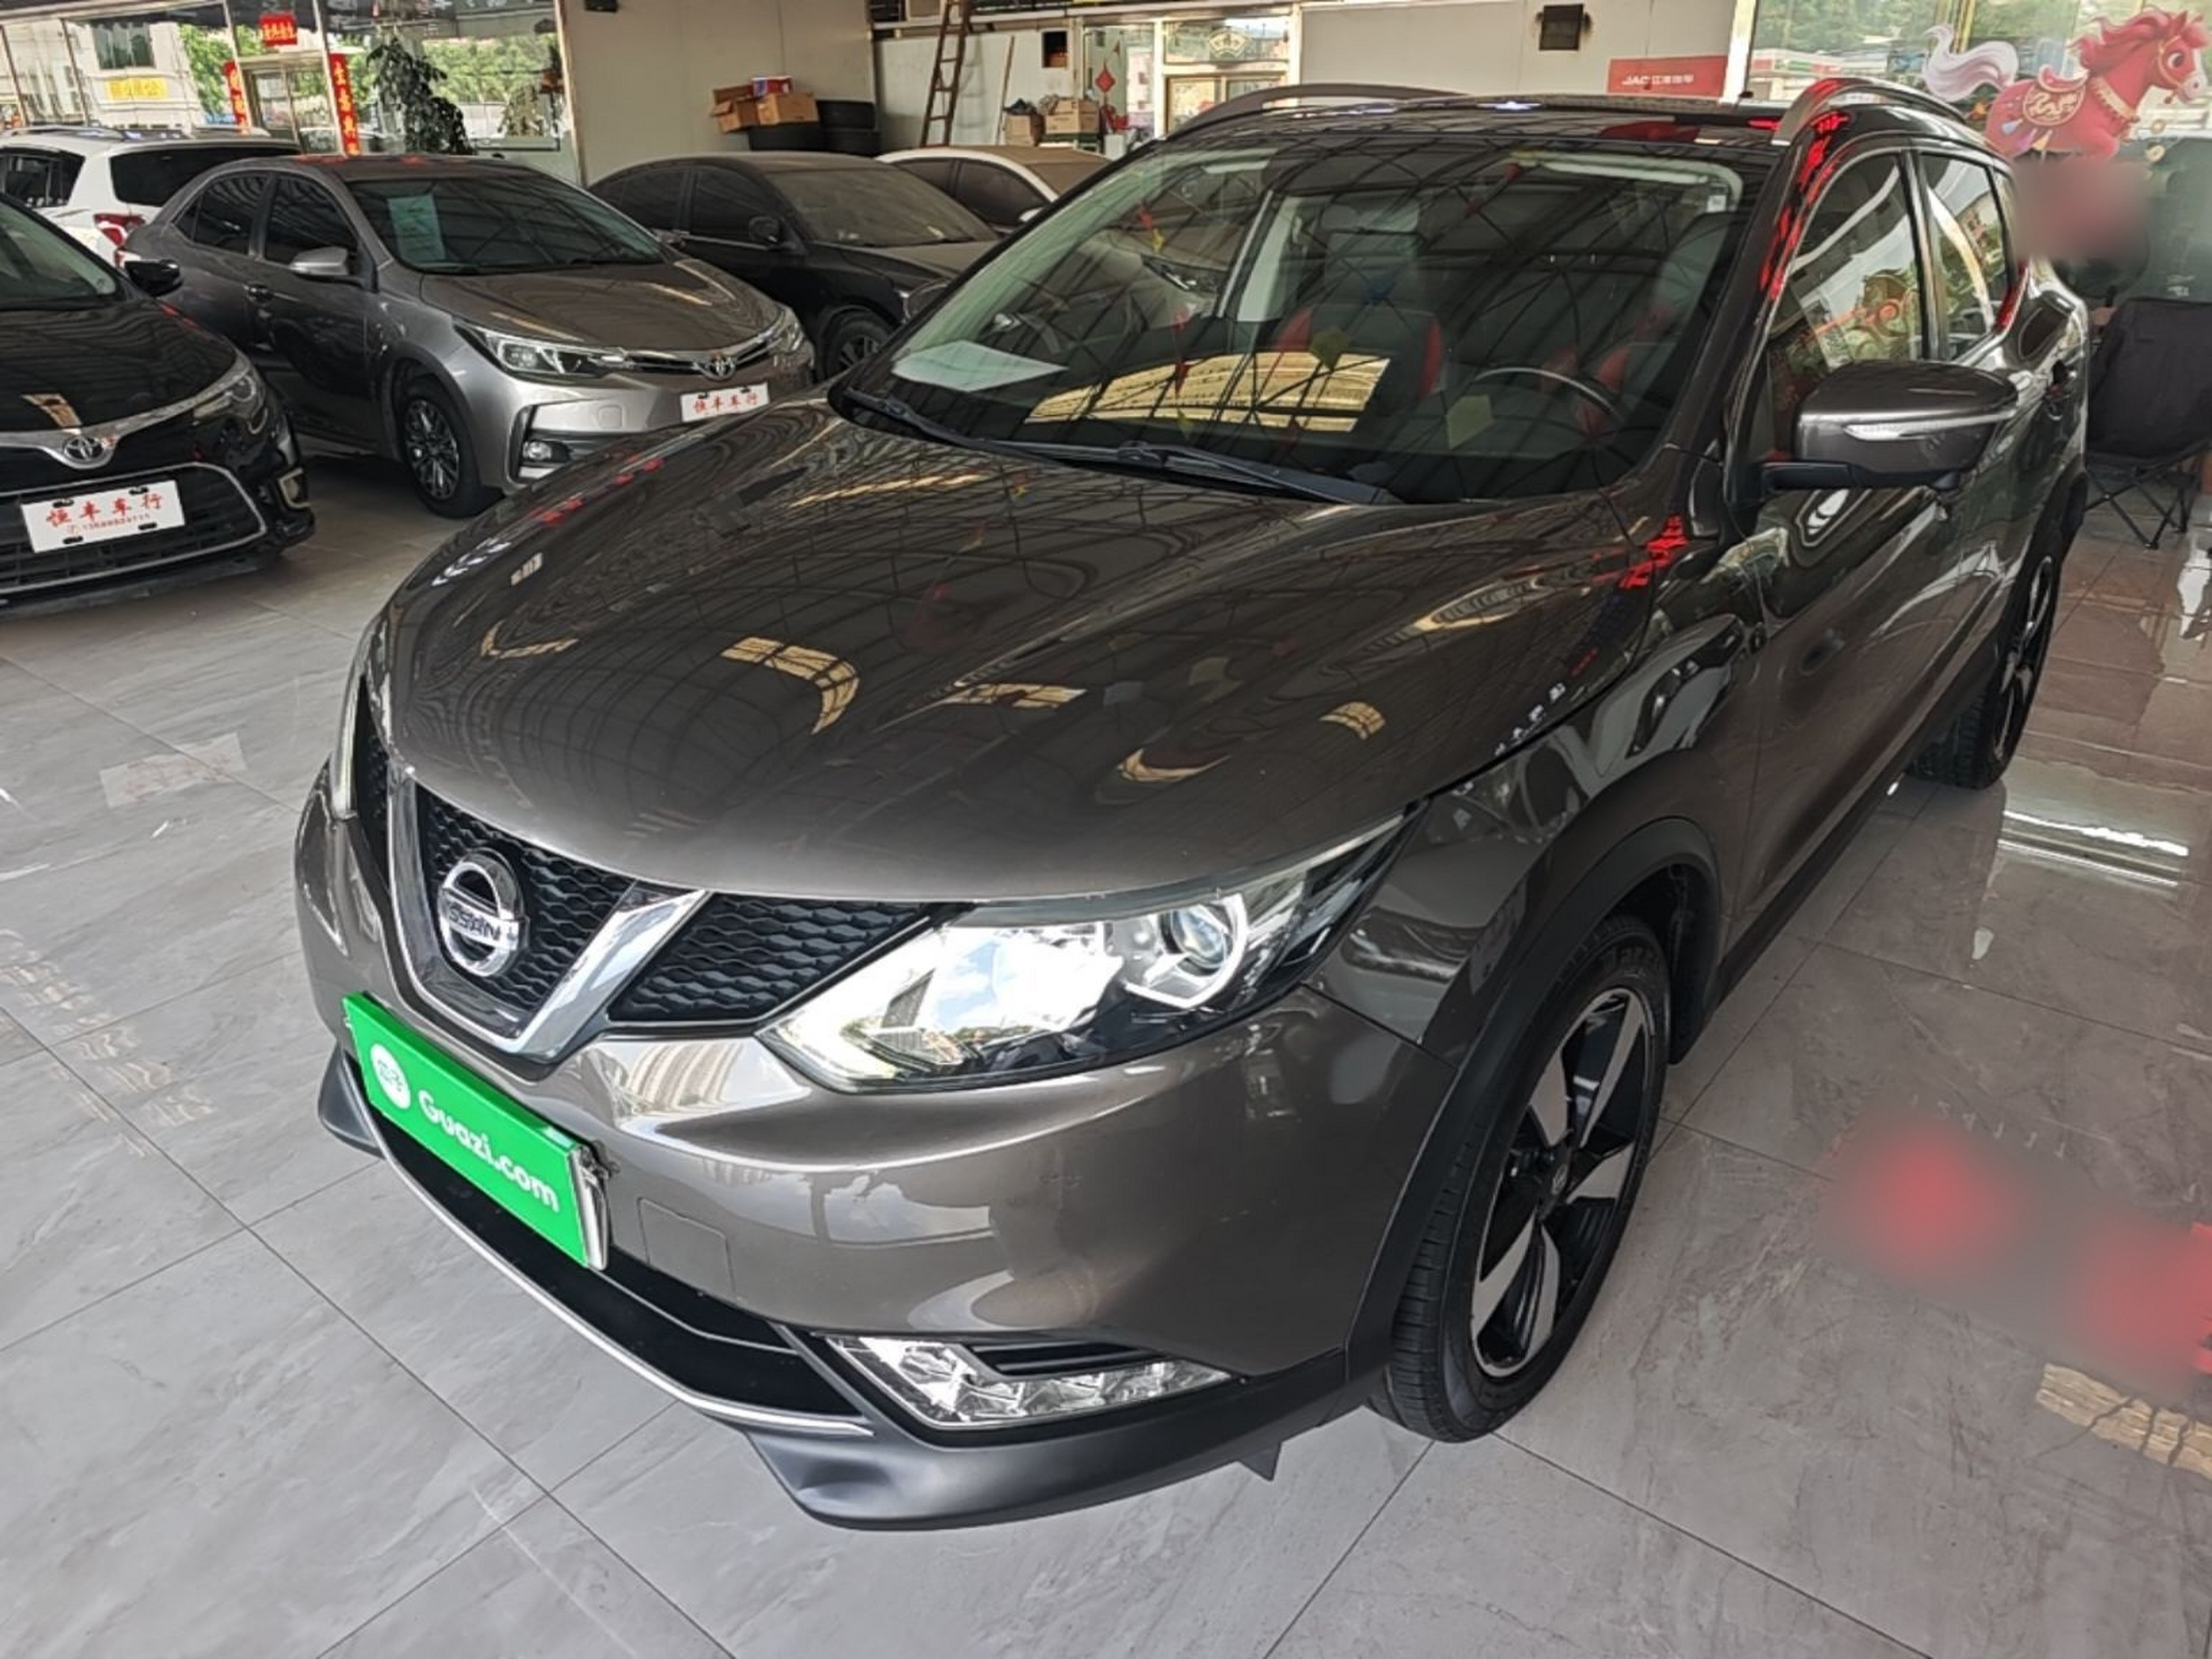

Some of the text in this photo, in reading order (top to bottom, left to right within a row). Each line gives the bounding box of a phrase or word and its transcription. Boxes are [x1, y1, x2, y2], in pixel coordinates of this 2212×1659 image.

[1621, 75, 1651, 85] JAC
[442, 897, 501, 941] SSAN
[418, 1089, 559, 1213] Guazi.com
